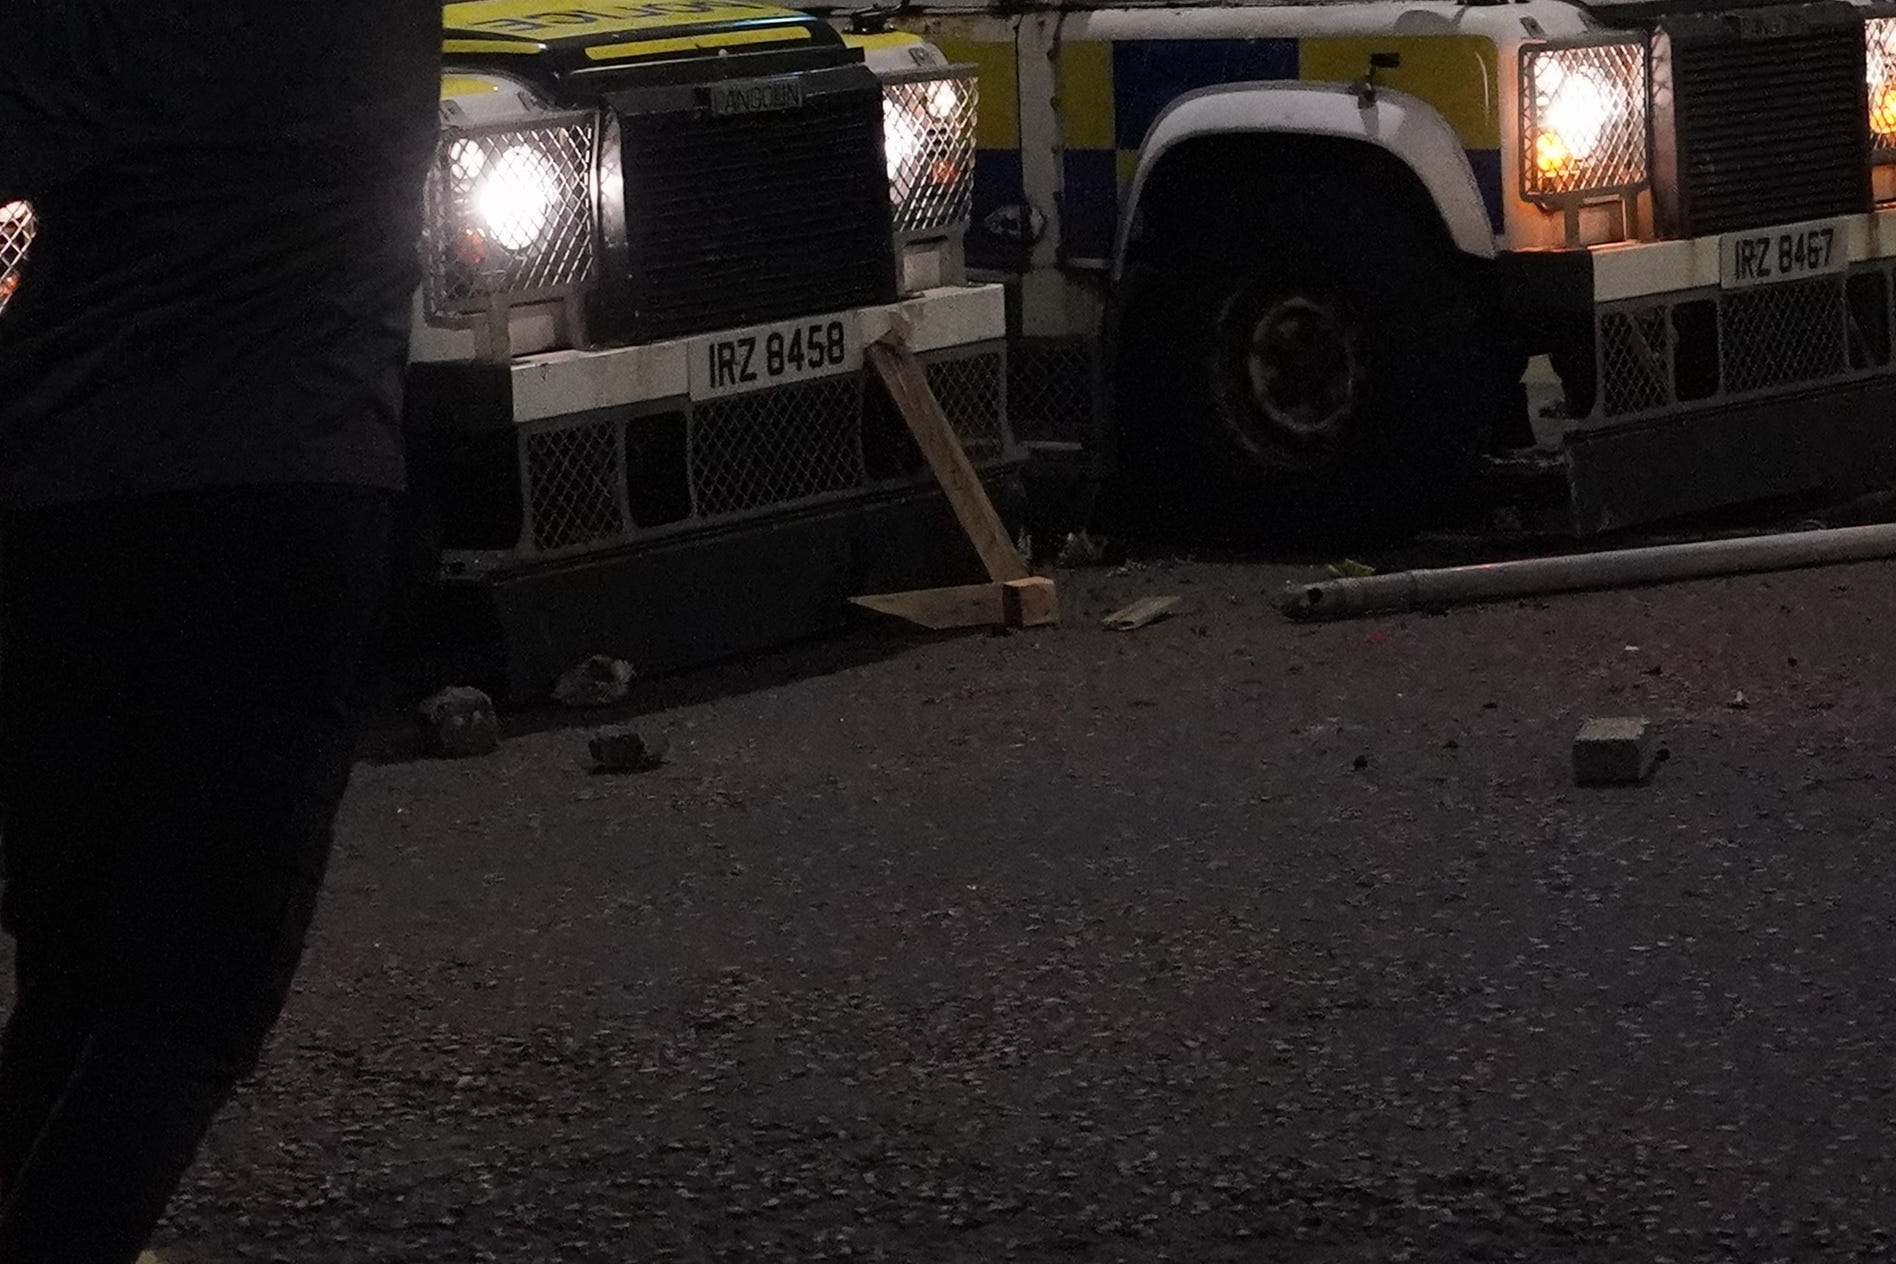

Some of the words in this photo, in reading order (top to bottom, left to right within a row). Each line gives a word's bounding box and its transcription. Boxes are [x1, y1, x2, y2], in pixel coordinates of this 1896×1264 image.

[1736, 237, 1771, 281] IRZ
[1779, 228, 1834, 274] 8467
[710, 337, 758, 387] IRZ
[766, 321, 844, 376] 8458
